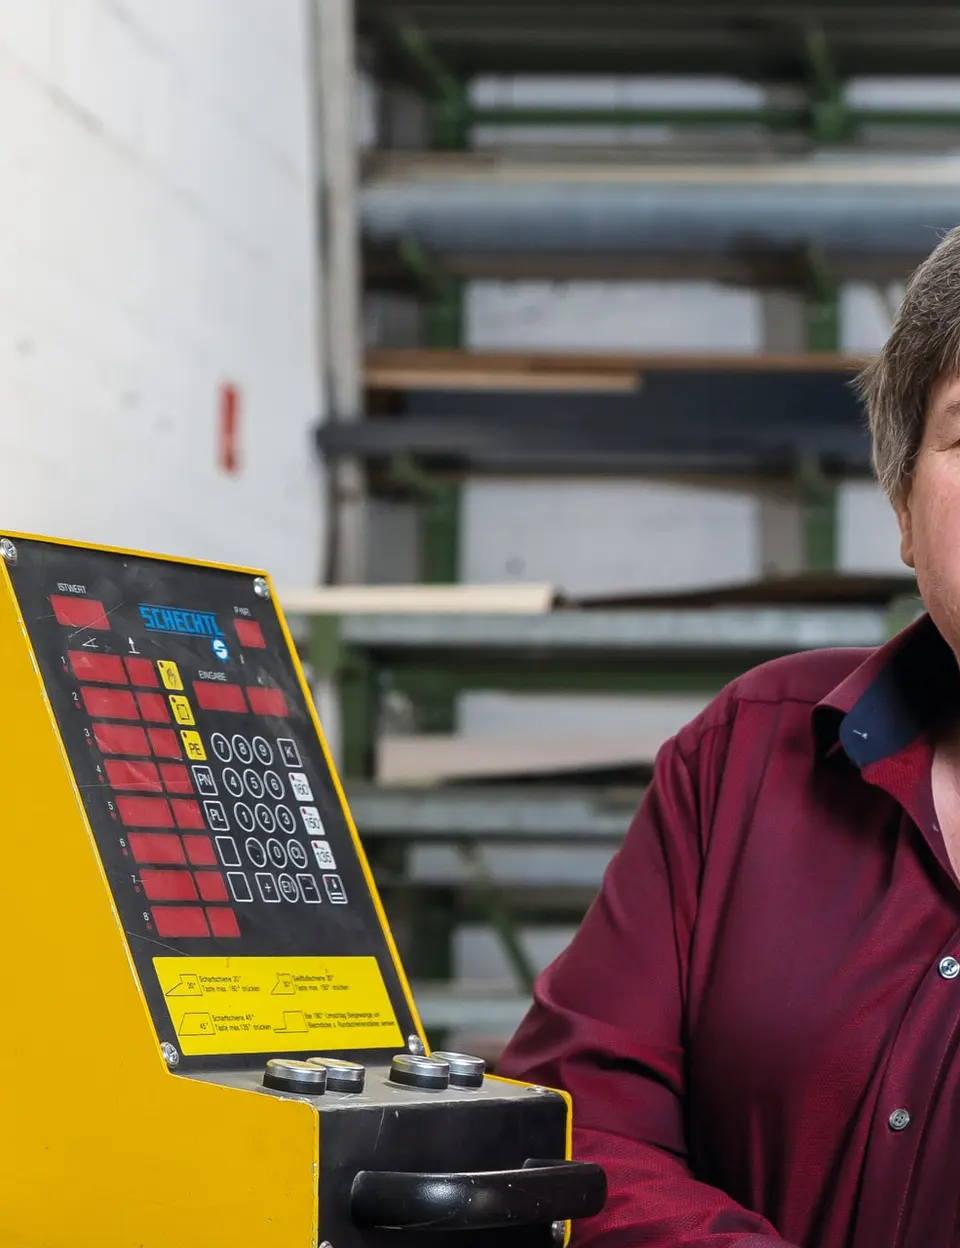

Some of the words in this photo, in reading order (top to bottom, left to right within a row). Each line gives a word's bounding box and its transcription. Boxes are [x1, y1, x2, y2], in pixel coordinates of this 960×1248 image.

[57, 582, 87, 594] ISTWERT
[138, 604, 225, 638] SCHECHTL
[198, 670, 228, 681] EINGABE
[71, 691, 79, 701] 2
[83, 728, 90, 737] 3
[188, 742, 202, 756] PE
[217, 741, 225, 753] 7
[238, 743, 247, 755] 8
[258, 744, 268, 757] 9
[284, 746, 295, 759] K
[95, 764, 102, 773] 4
[197, 773, 213, 786] PN
[230, 776, 238, 788] 4
[250, 777, 258, 790] 5
[270, 778, 279, 791] 6
[107, 801, 114, 811] 5
[209, 808, 225, 822] PL
[261, 812, 271, 824] 2
[281, 813, 291, 825] 3
[119, 838, 126, 847] 6
[130, 874, 136, 884] 7
[142, 911, 150, 921] 8
